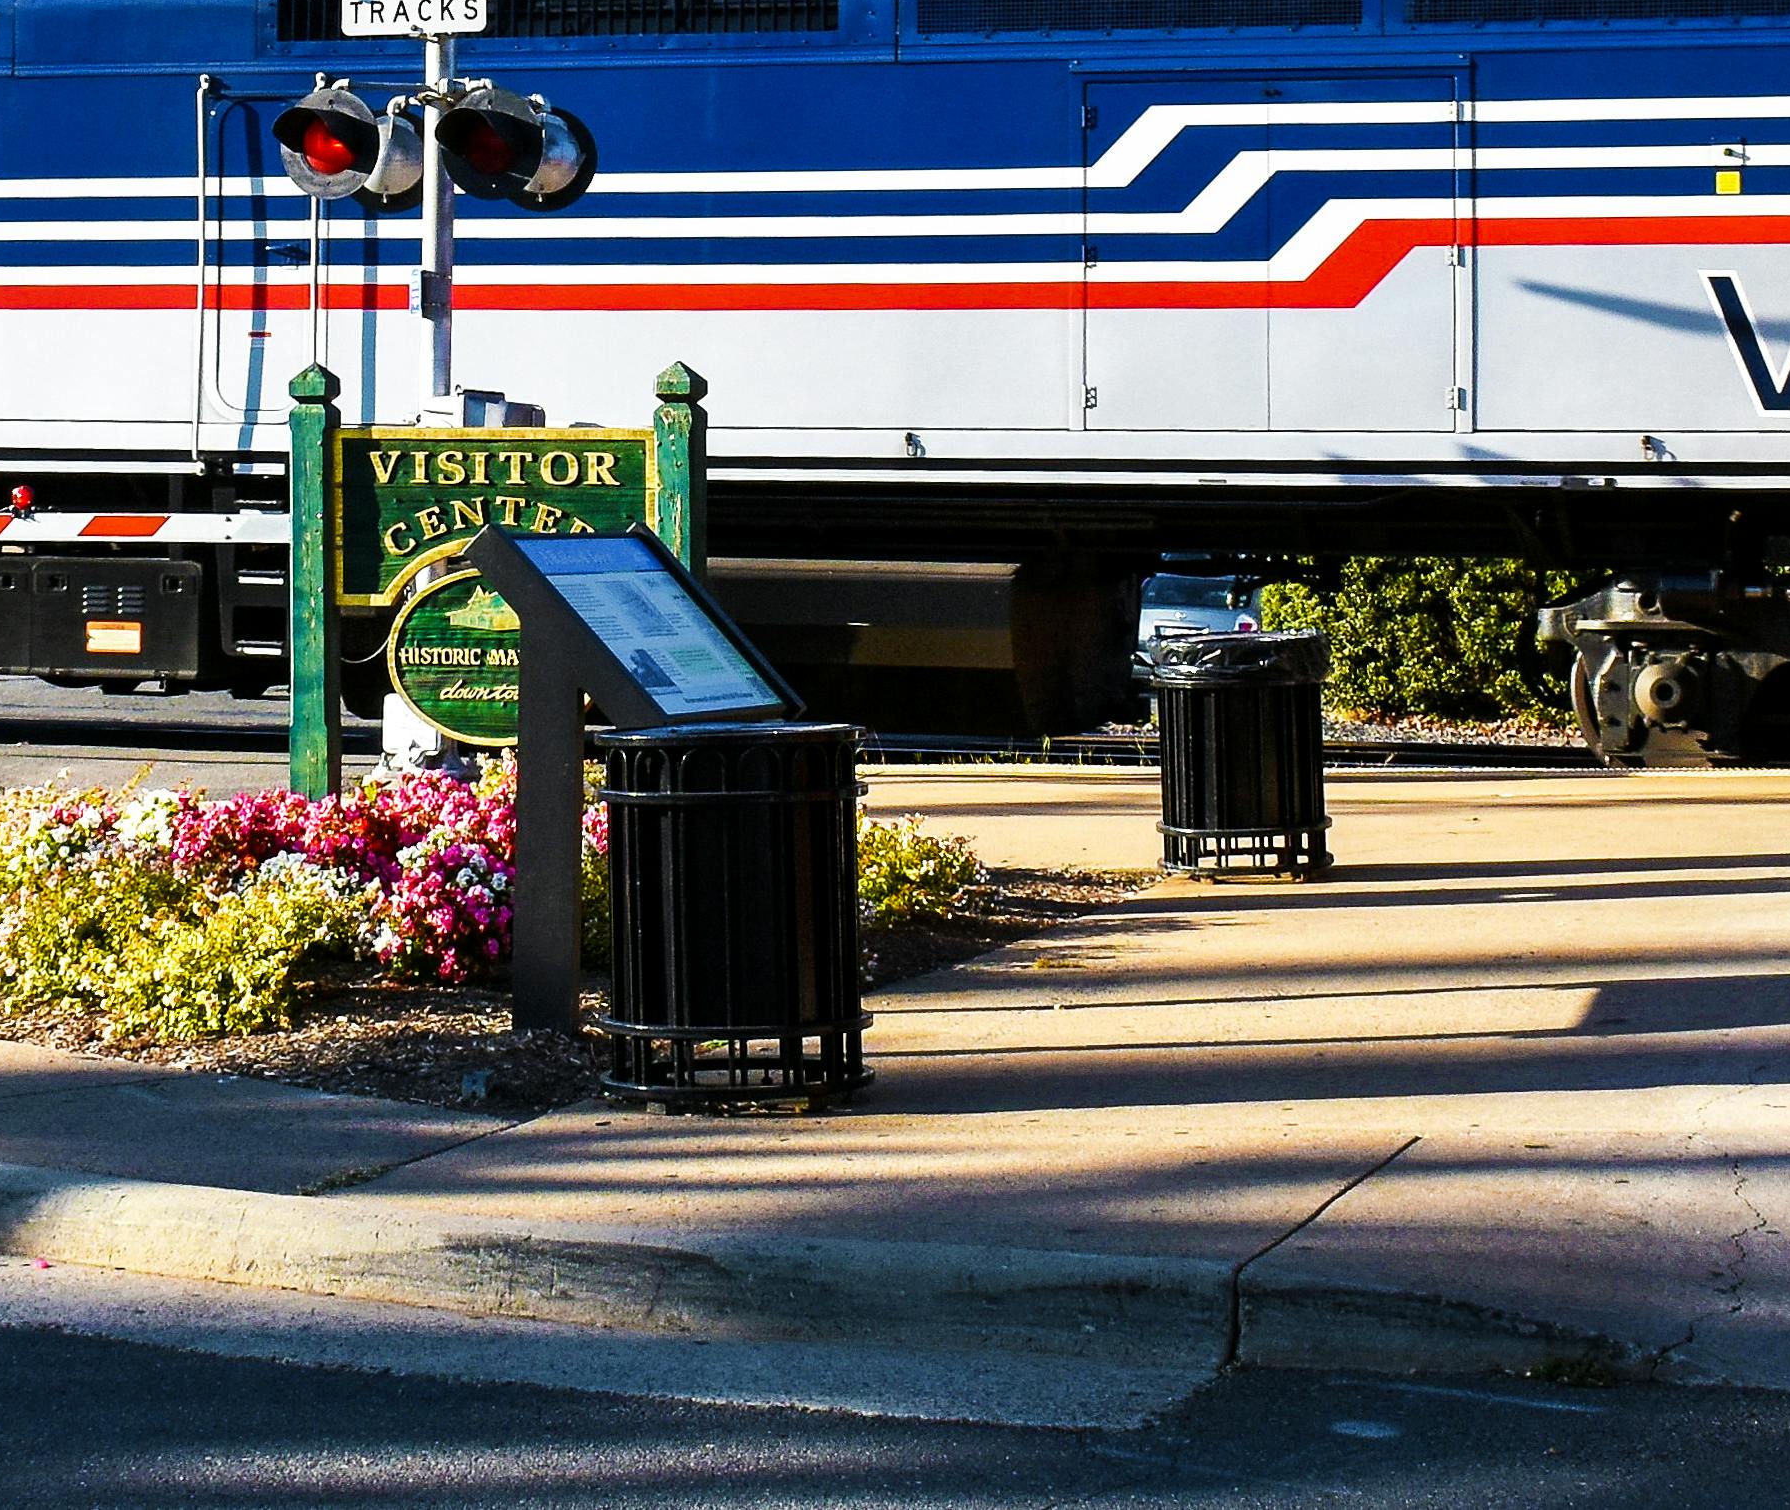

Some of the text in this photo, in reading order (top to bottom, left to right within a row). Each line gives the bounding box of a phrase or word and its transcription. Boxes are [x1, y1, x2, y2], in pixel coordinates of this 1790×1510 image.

[369, 450, 620, 486] VISITOR
[399, 647, 520, 666] HISTORIC MA
[439, 679, 519, 700] downto
